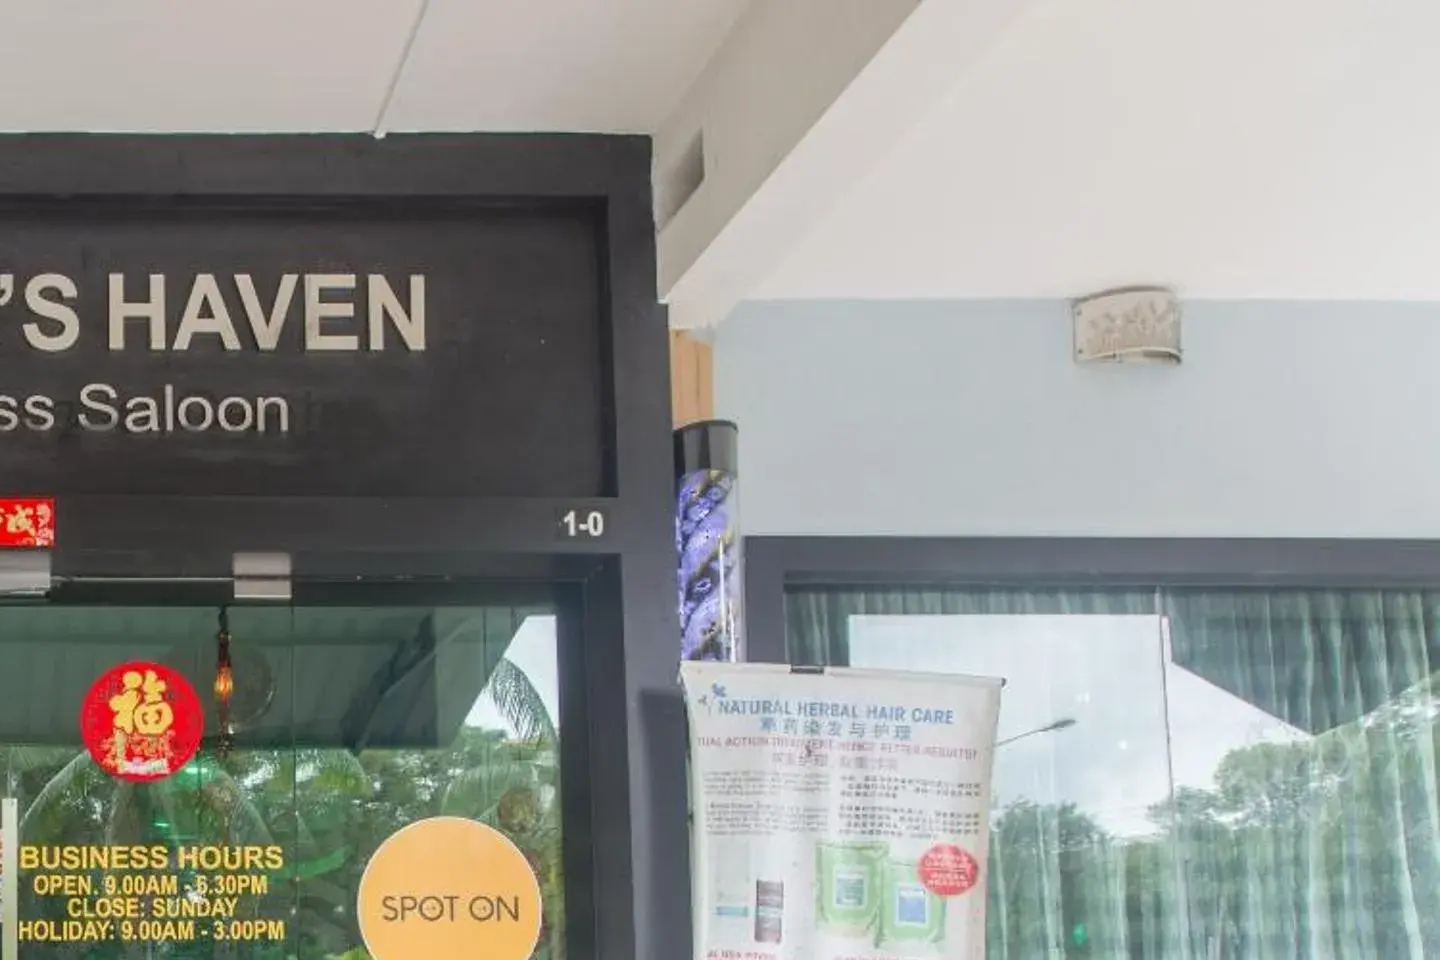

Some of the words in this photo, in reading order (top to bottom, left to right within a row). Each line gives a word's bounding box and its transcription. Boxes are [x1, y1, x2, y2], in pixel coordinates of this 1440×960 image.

[107, 272, 427, 352] HAVEN
[77, 382, 289, 433] Saloon
[563, 510, 604, 537] 1-0
[108, 669, 175, 735] 福
[718, 698, 791, 716] NATURAL
[796, 700, 859, 719] HERBAL
[866, 705, 906, 722] HAIR
[911, 707, 954, 725] CARE
[20, 845, 169, 869] BUSINESS
[177, 845, 284, 869] HOURS
[104, 874, 178, 896] 9.00AM
[67, 897, 146, 918] CLOSE:
[151, 896, 239, 918] SUNDAY
[381, 895, 460, 922] SPOT
[468, 895, 520, 922] ON
[18, 920, 115, 941] HOLIDAY:
[120, 920, 195, 941] 9.00AM
[213, 920, 285, 941] 3.00PM
